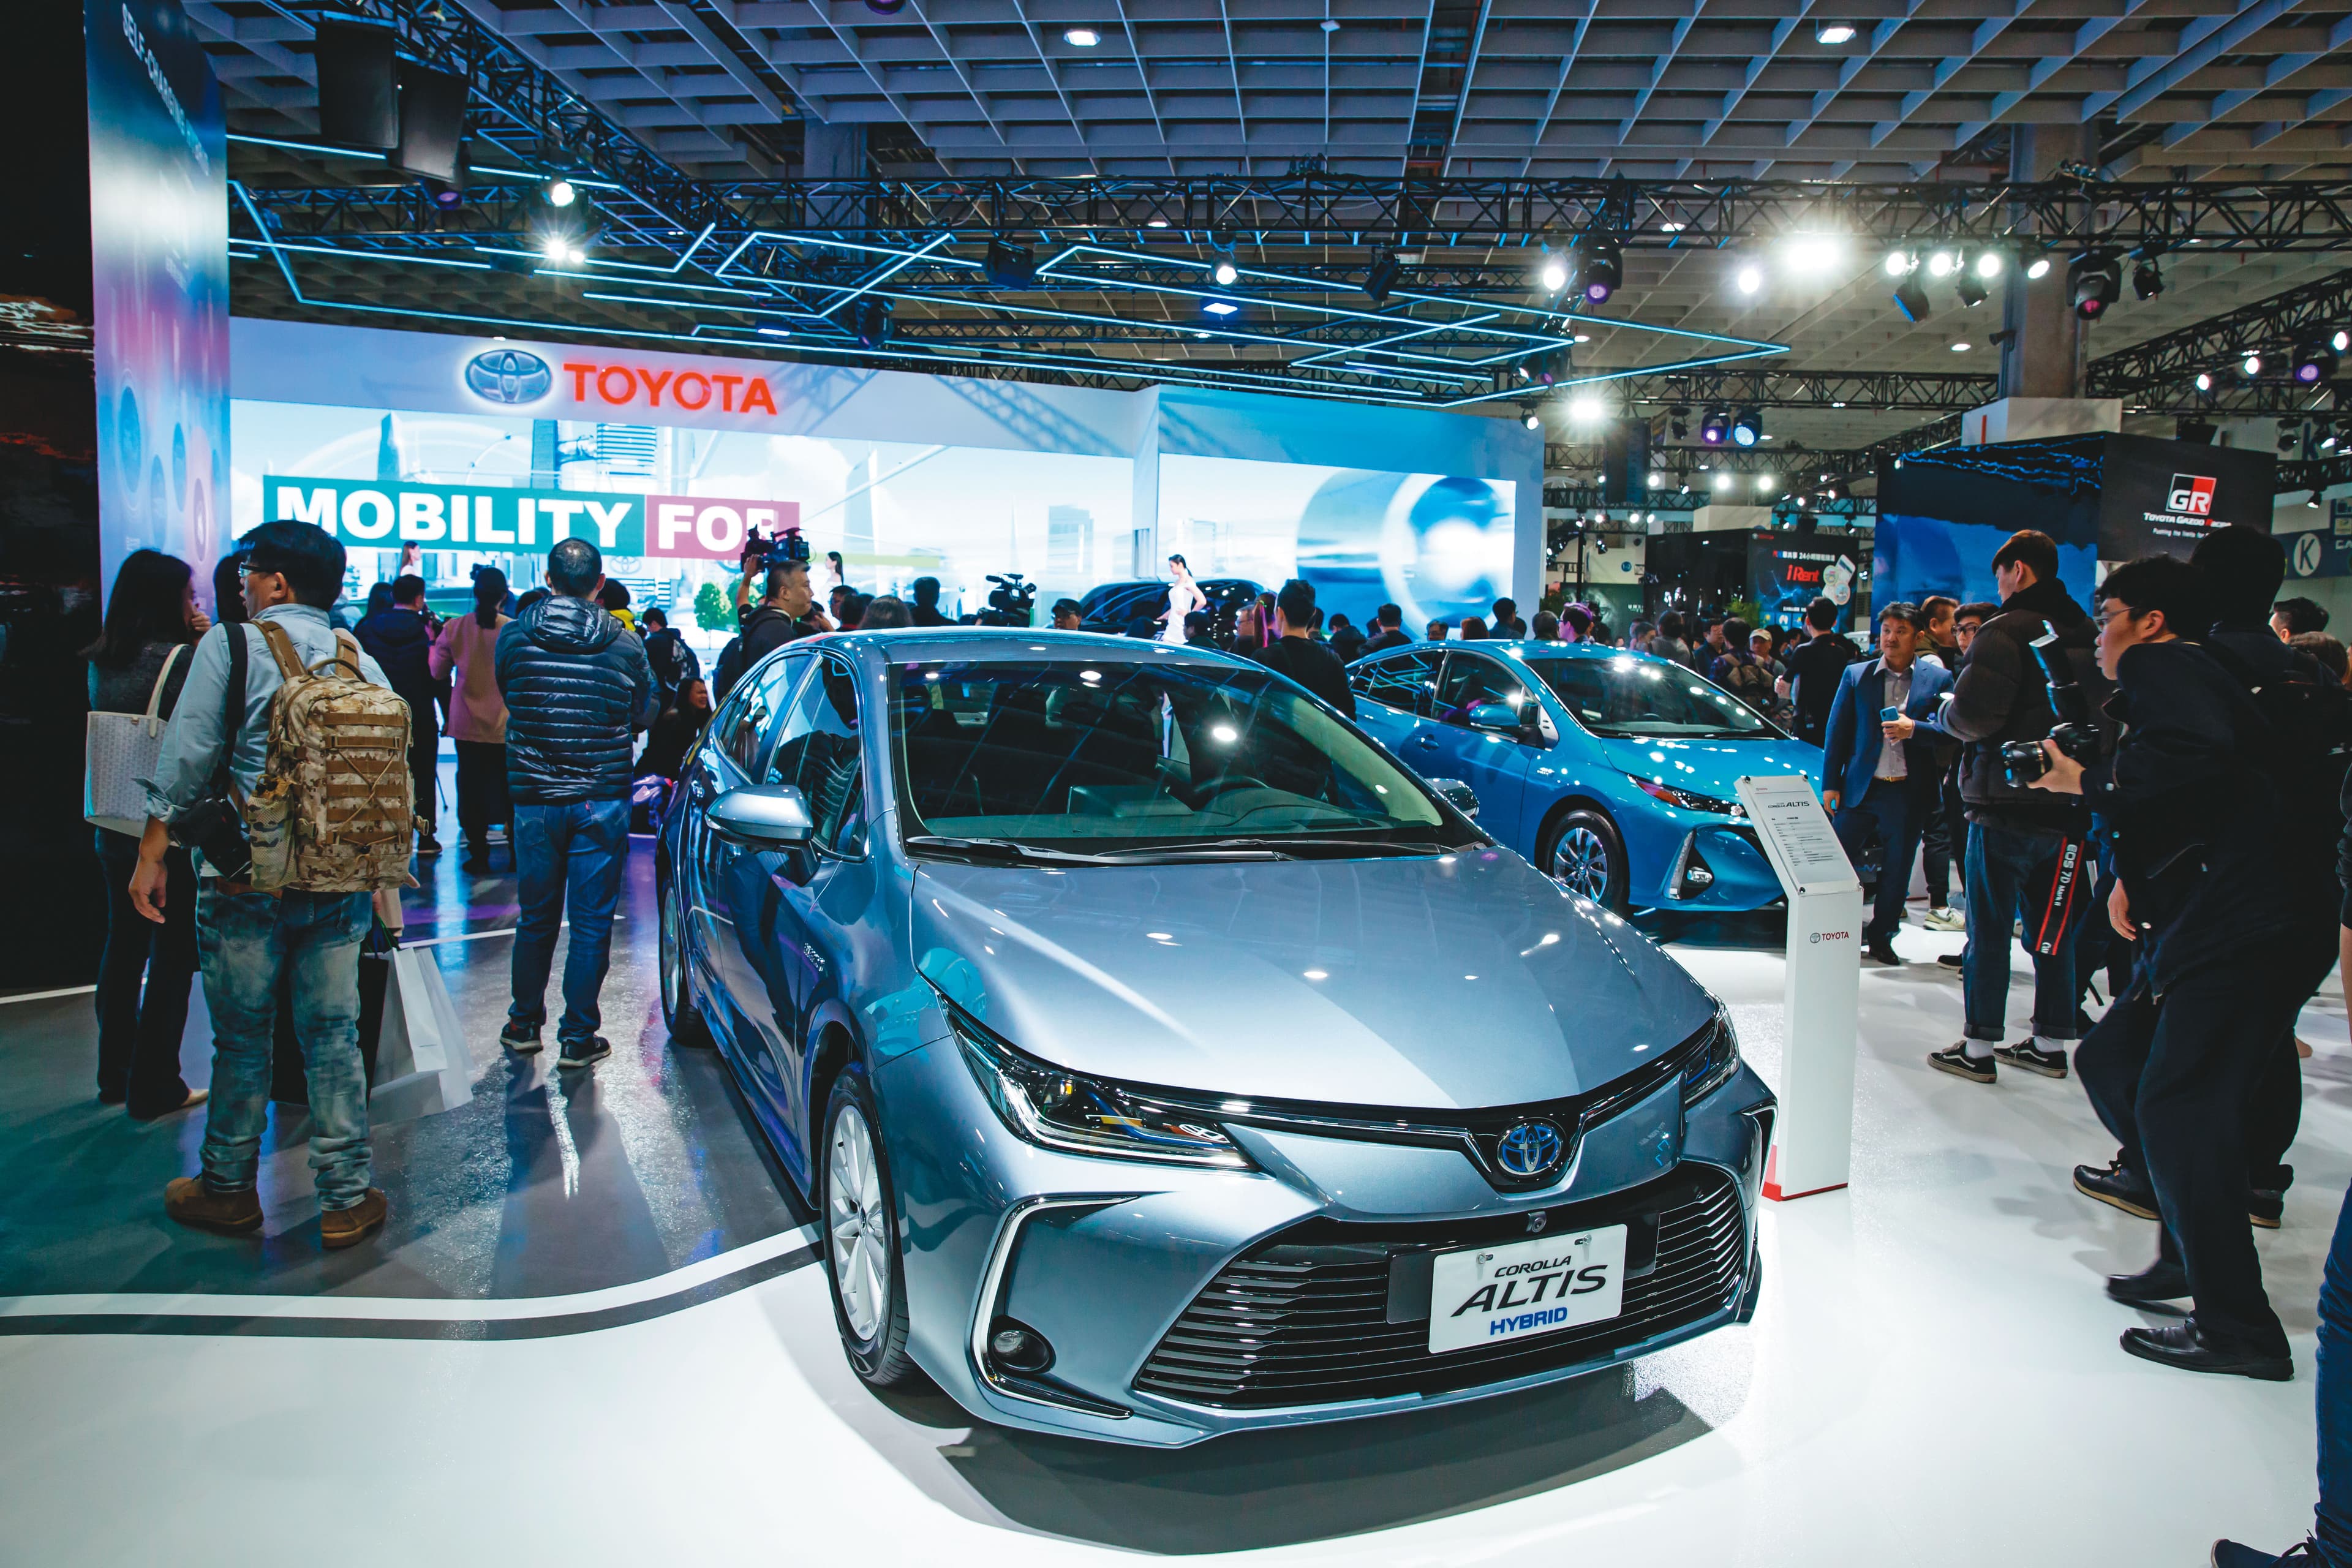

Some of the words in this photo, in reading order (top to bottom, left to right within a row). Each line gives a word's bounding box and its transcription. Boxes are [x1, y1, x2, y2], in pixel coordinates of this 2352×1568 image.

[563, 363, 777, 415] TOYOTA
[2169, 489, 2211, 513] GR
[277, 486, 632, 548] MOBILITY
[2143, 512, 2176, 523] TOYOTA
[2299, 538, 2316, 570] K
[2062, 844, 2078, 869] EOS
[2059, 872, 2072, 884] 7D
[2056, 884, 2066, 902] Mark
[1821, 931, 1849, 941] TOYOTA
[1494, 1255, 1572, 1278] COROLLA
[1450, 1264, 1608, 1317] ALTIS
[1490, 1306, 1568, 1336] HYBRID
